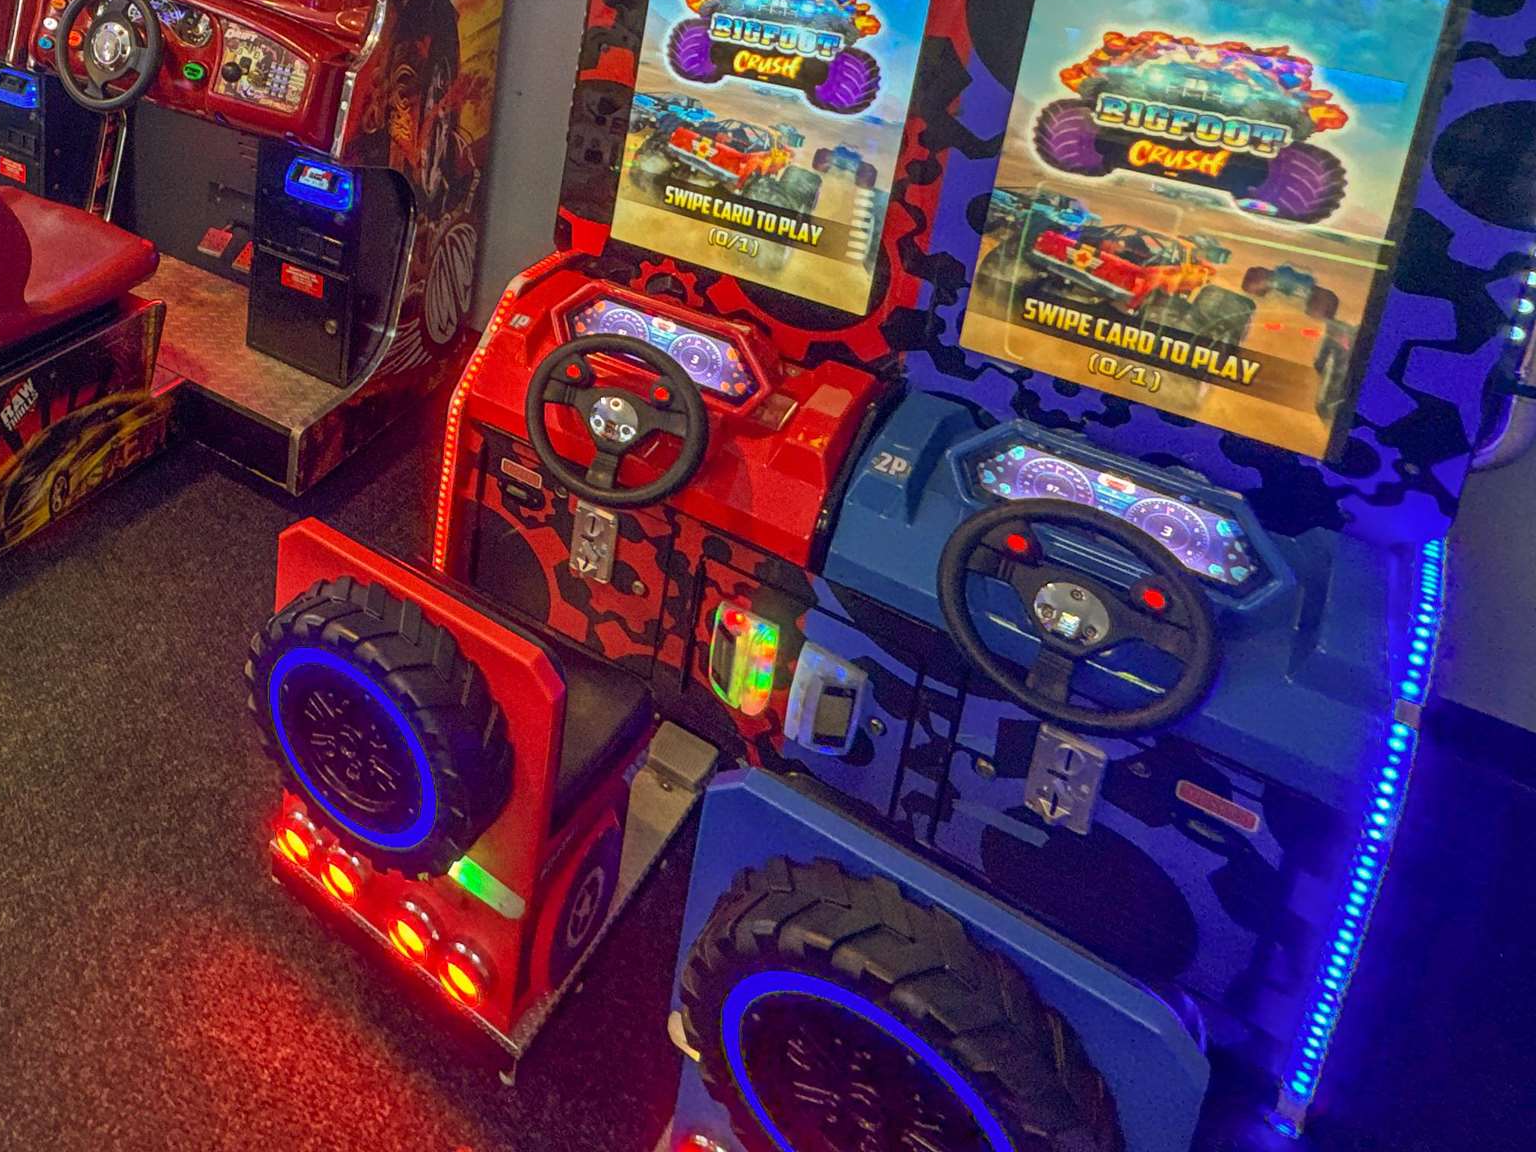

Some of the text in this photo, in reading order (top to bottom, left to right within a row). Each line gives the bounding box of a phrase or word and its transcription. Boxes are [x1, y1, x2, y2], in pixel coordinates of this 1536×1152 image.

[711, 14, 842, 58] BIGFOOT
[733, 49, 805, 80] CRUSH
[1097, 96, 1286, 153] BIGFOOT
[1127, 139, 1233, 178] CRUSH
[664, 184, 824, 247] SWIPE CARD TO PLAY
[707, 227, 760, 258] (0/1)
[1023, 297, 1261, 386] SWIPE CARD TO PLAY
[1087, 352, 1162, 393] (0/1)
[0, 376, 37, 428] RAW
